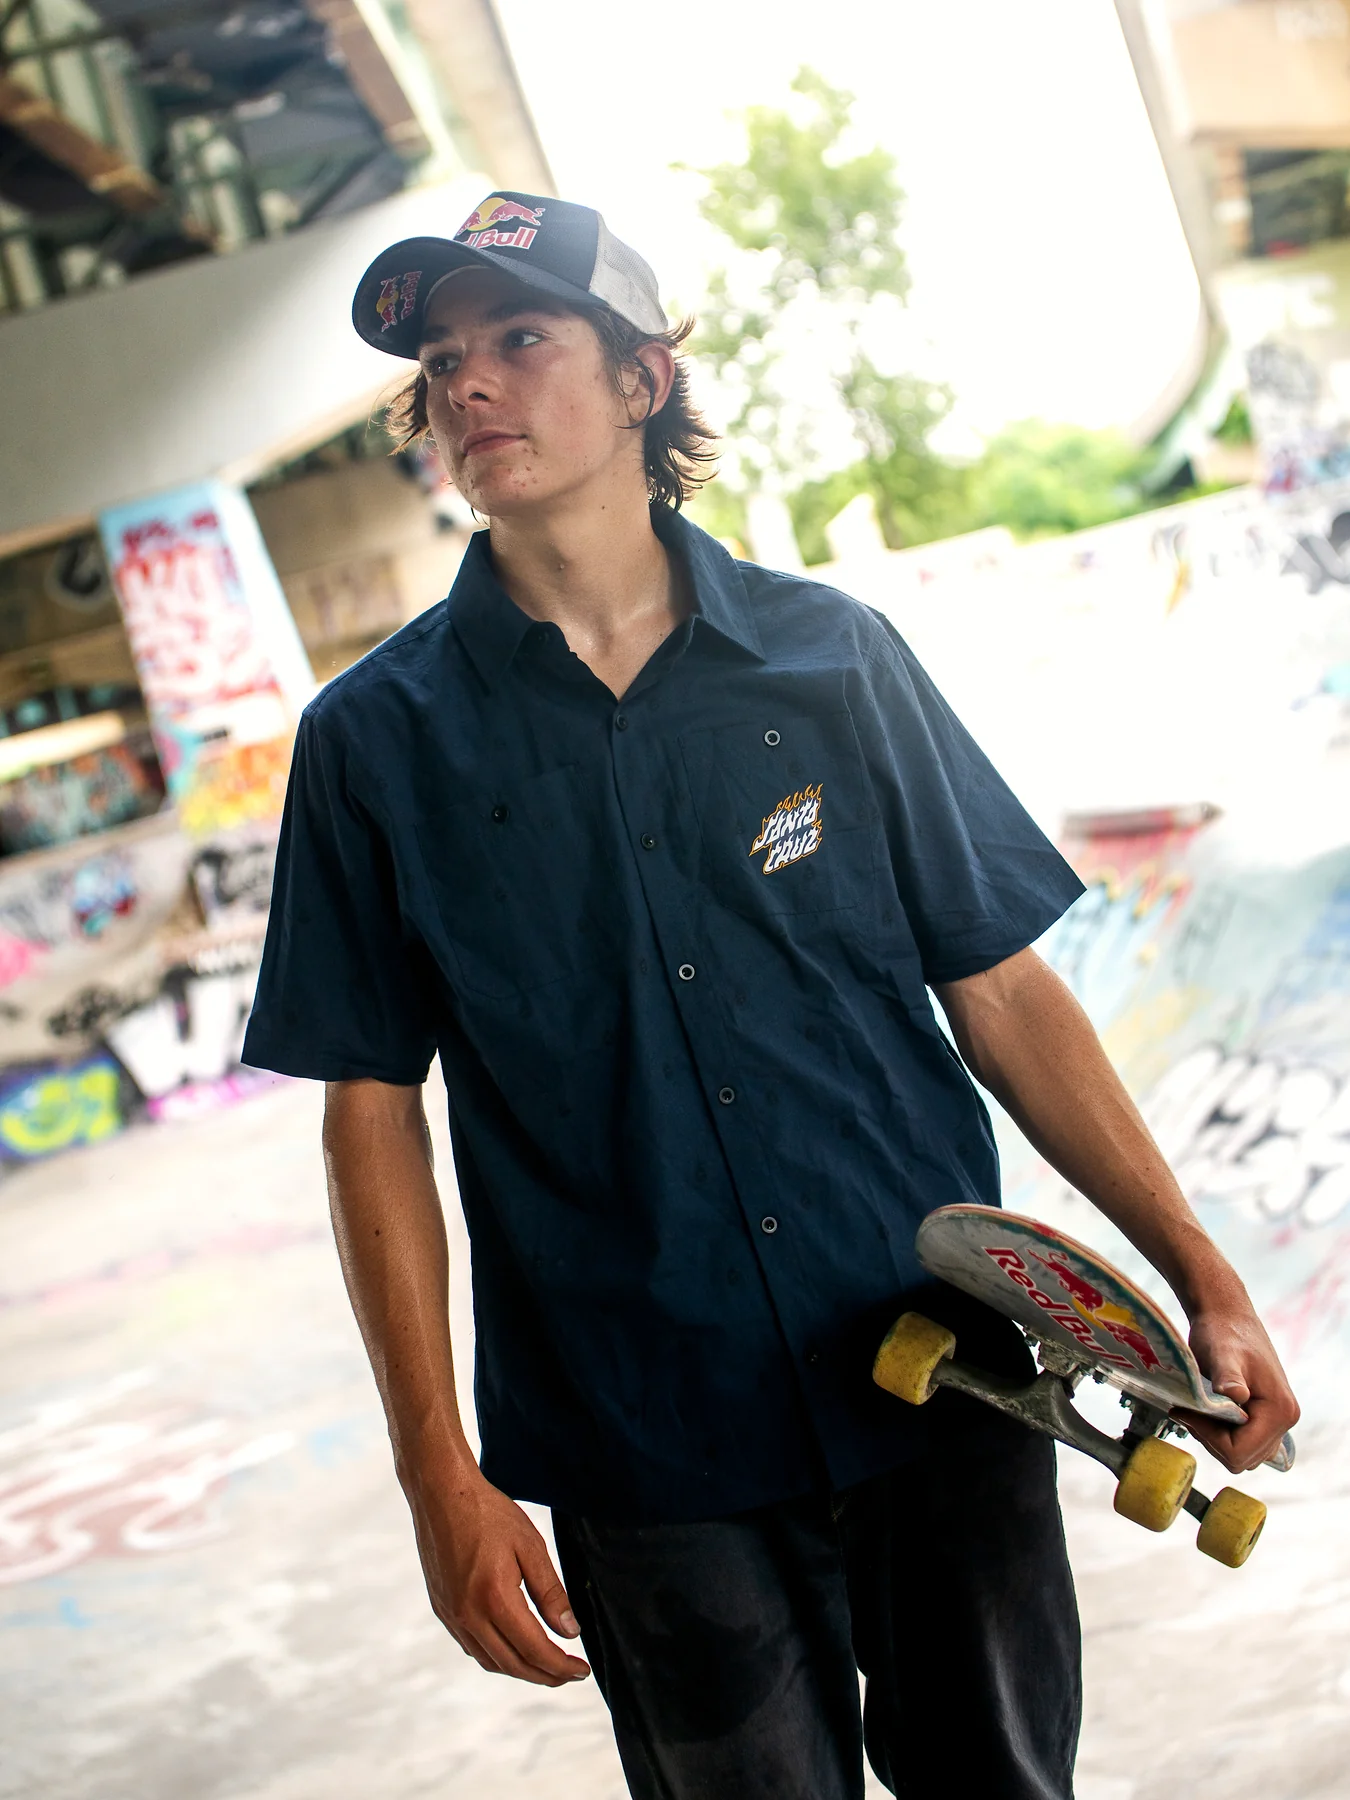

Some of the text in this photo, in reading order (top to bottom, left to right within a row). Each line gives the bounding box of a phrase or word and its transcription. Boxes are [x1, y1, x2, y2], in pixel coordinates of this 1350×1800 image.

[474, 226, 538, 249] Bull
[401, 289, 416, 320] Red
[981, 1247, 1139, 1371] Red Bull
